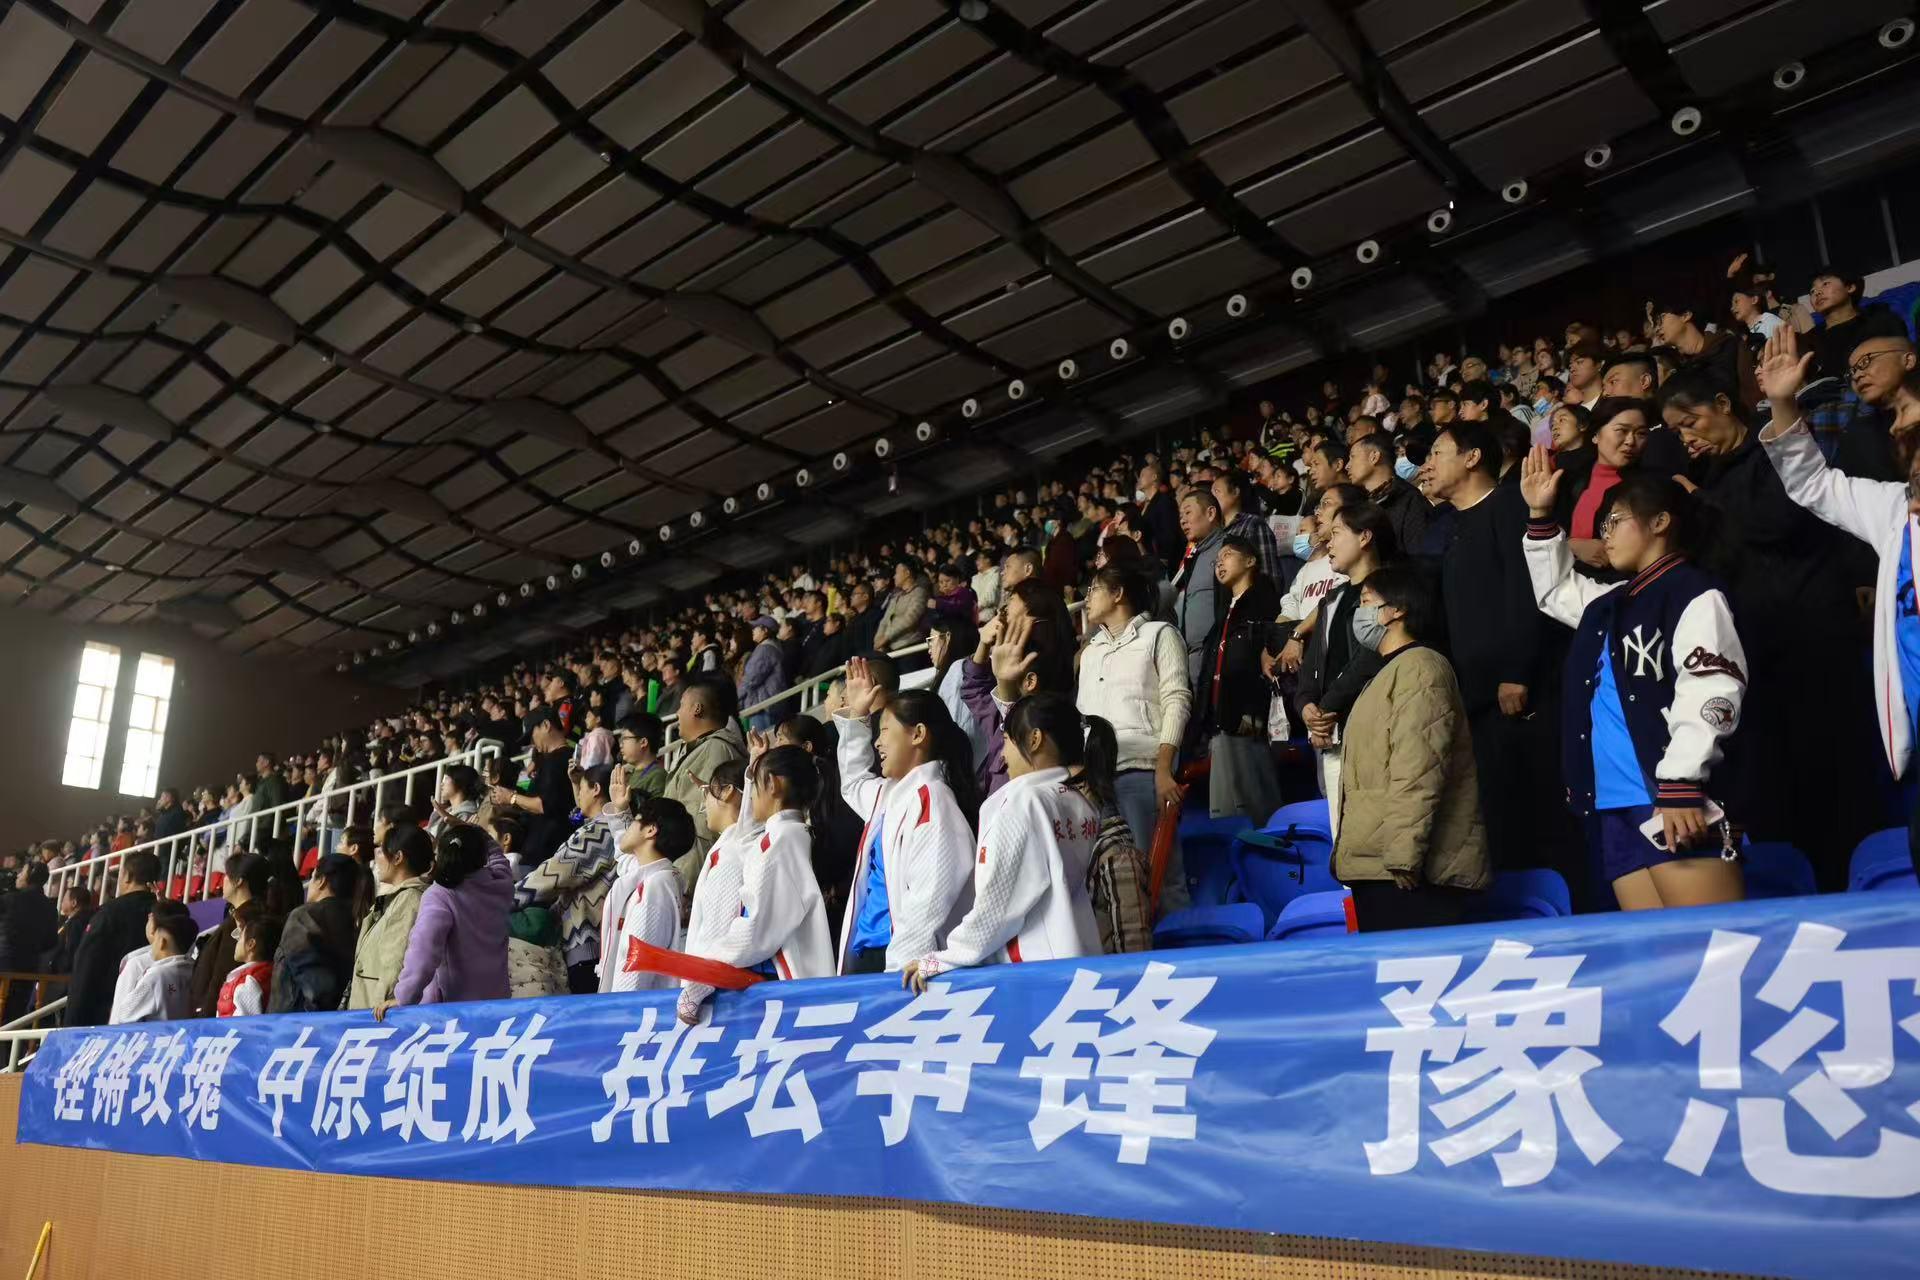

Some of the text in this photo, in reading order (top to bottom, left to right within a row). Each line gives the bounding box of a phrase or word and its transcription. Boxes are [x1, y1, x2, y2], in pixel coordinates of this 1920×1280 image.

[1622, 624, 1664, 682] NY
[54, 922, 1920, 1198] 铿锵玫瑰 中原绽放 排坛争锋 豫您
